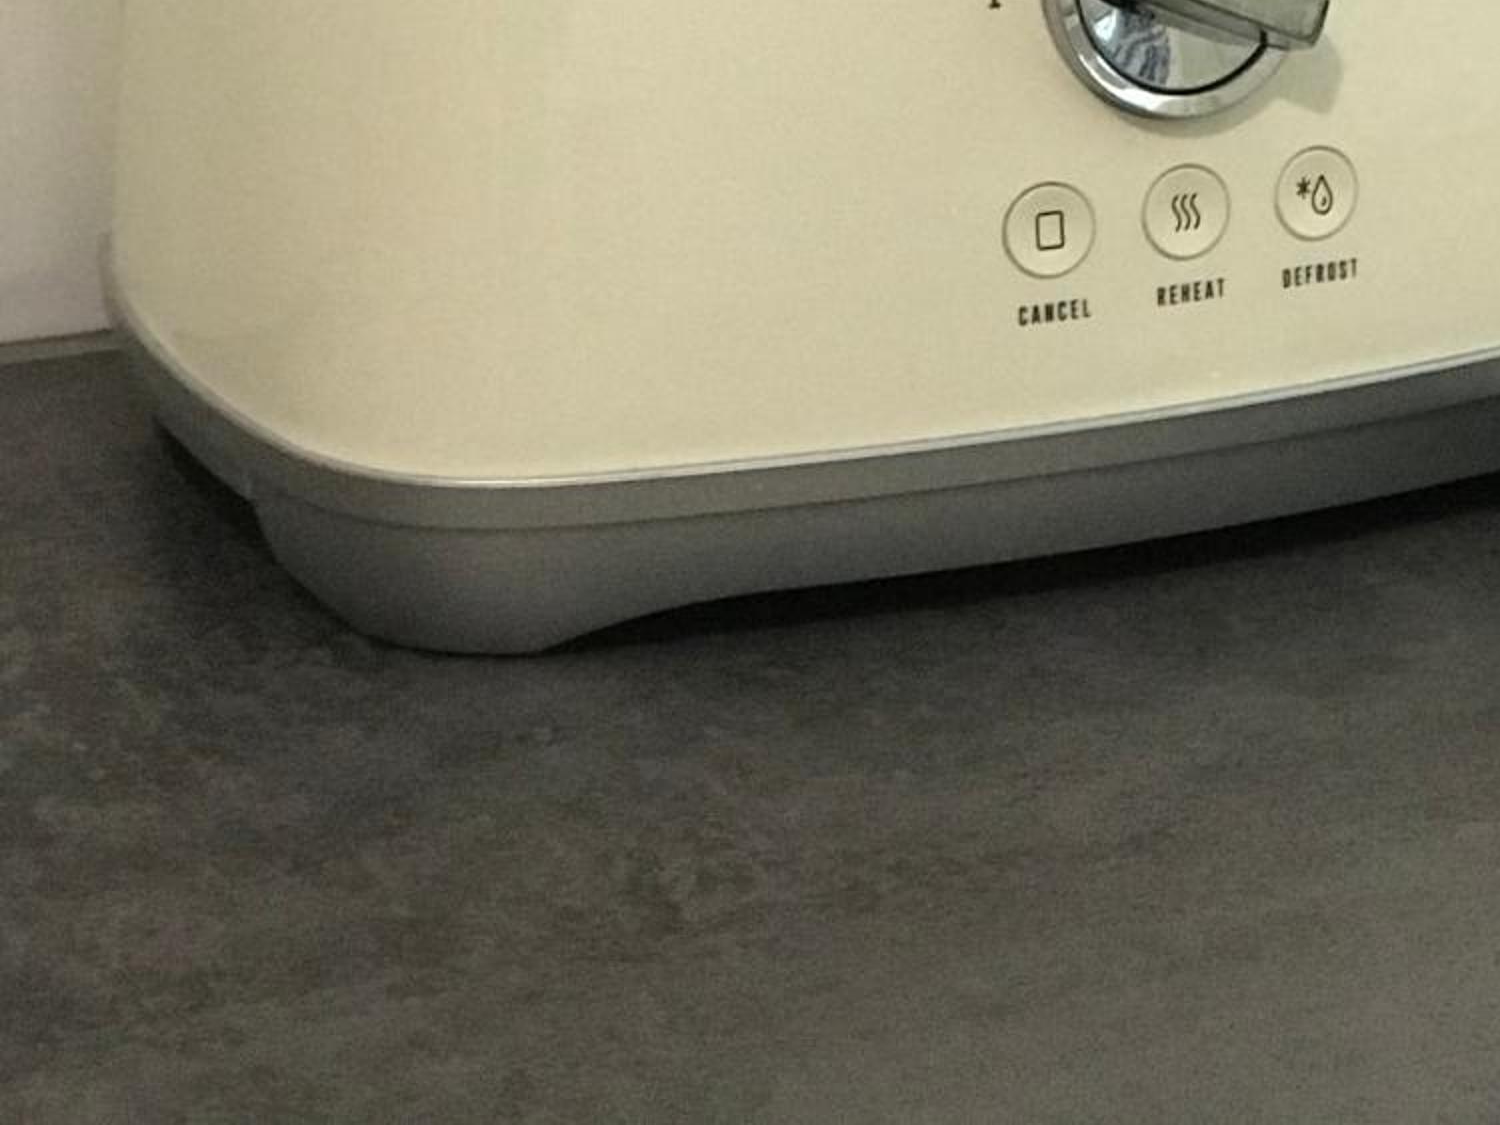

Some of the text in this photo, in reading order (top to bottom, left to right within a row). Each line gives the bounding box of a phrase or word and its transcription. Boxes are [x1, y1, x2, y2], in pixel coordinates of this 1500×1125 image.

[1281, 258, 1359, 289] DEFROST
[1156, 277, 1226, 306] REHEAT
[1017, 298, 1092, 327] CANCEL
